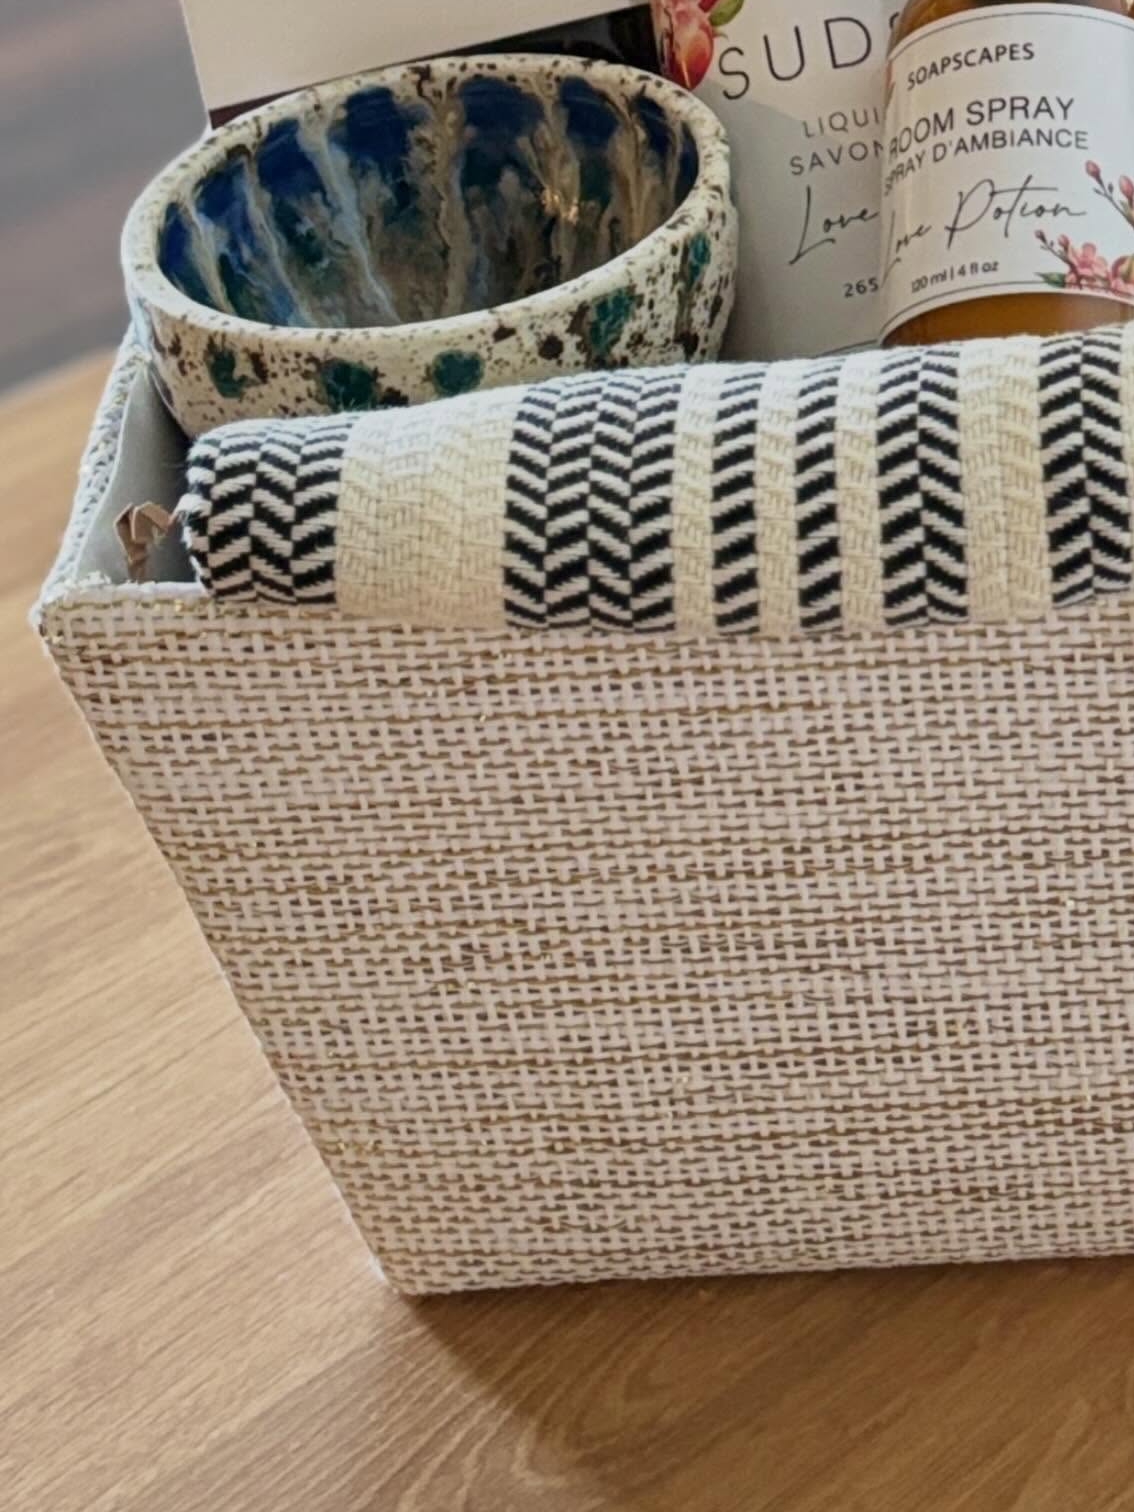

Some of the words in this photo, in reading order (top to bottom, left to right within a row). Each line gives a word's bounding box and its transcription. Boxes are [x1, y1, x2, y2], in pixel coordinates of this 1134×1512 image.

[907, 41, 1035, 91] SOAPSCAPES
[802, 107, 880, 139] LIQUI
[888, 106, 955, 166] ROOM
[966, 95, 1075, 127] SPRAY
[932, 128, 1089, 164] D'AMBIANCE
[789, 184, 880, 265] Love
[944, 174, 1086, 251] Potion
[843, 277, 880, 298] 265
[930, 270, 948, 284] ml
[958, 265, 966, 278] 4
[981, 260, 999, 272] oz
